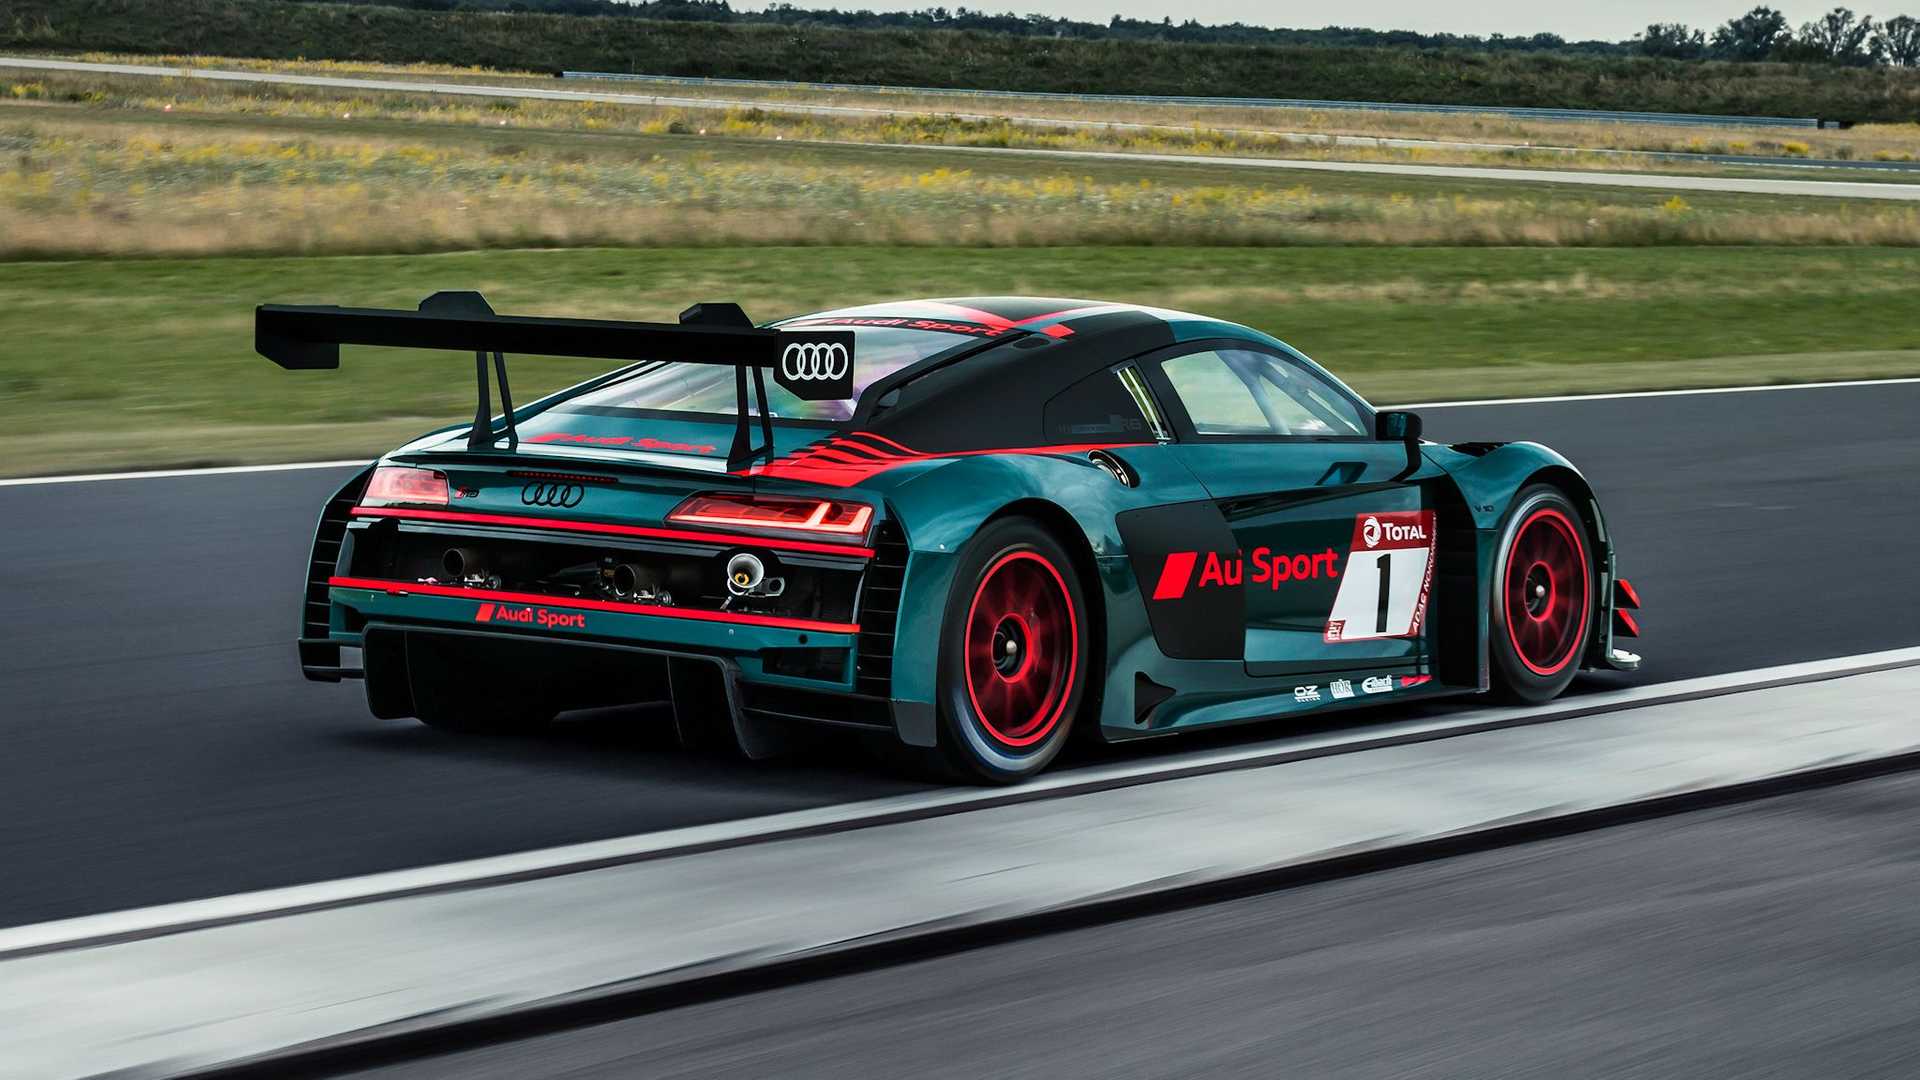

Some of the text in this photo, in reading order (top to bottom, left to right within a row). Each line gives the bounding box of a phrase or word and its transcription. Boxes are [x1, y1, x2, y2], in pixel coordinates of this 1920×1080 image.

[908, 320, 1003, 336] Sport
[1382, 522, 1427, 541] TOTAL
[1252, 547, 1338, 591] Sport
[1376, 553, 1391, 633] 1
[495, 604, 586, 629] Audi Sport
